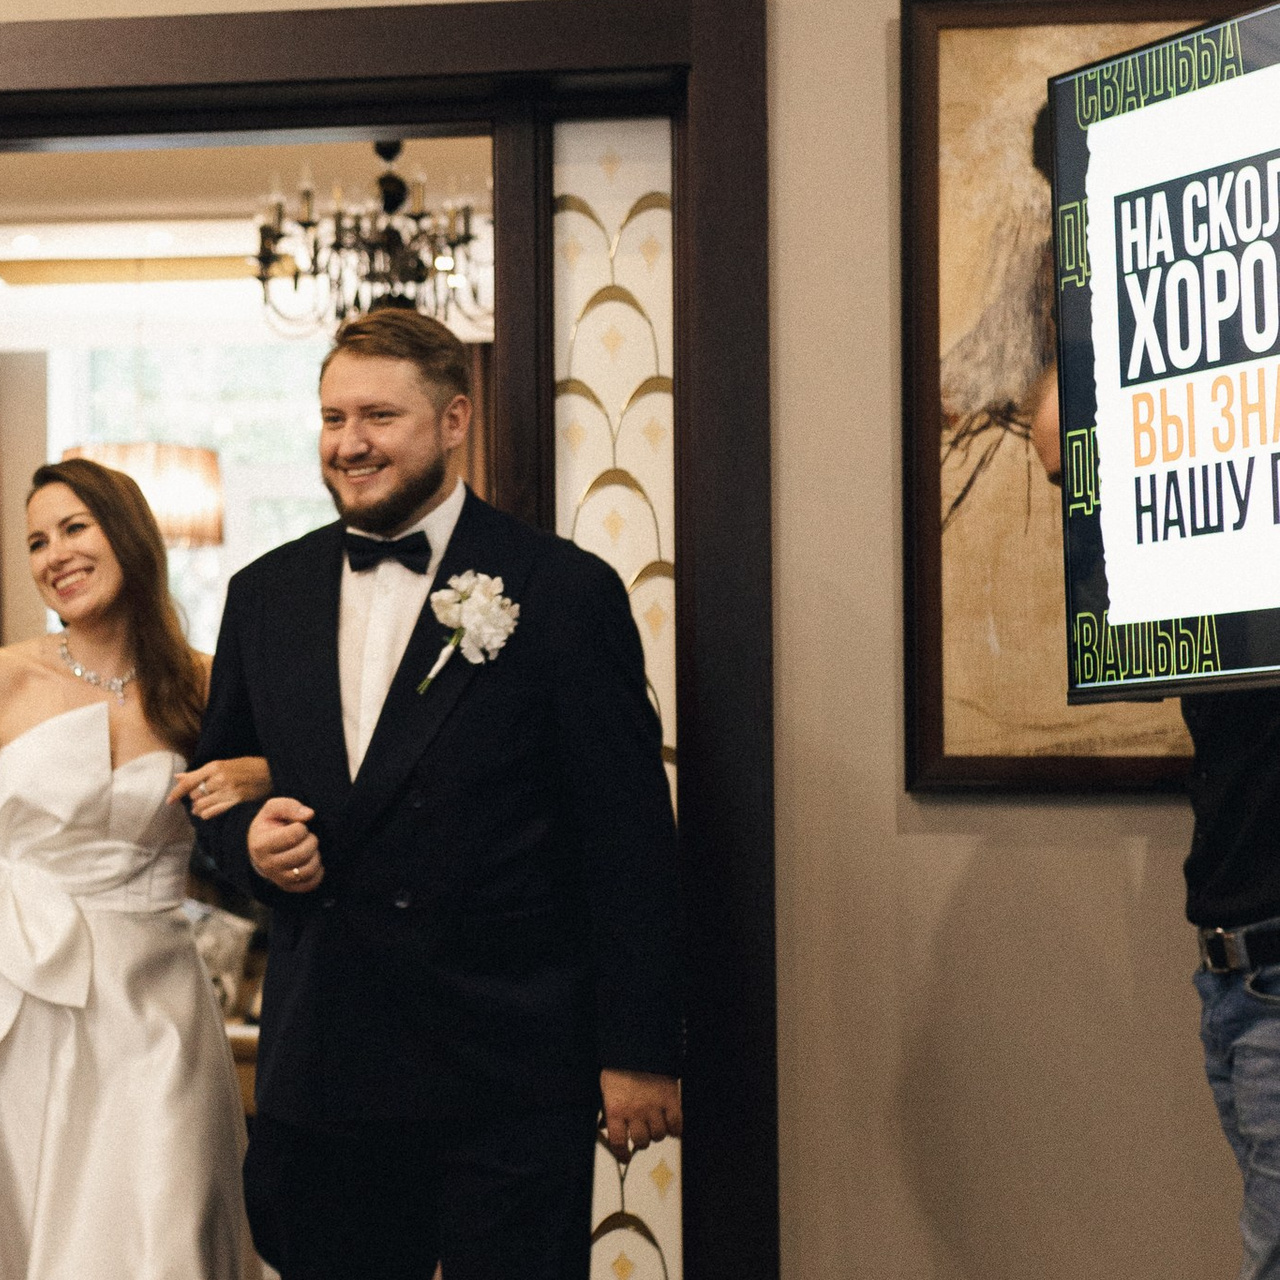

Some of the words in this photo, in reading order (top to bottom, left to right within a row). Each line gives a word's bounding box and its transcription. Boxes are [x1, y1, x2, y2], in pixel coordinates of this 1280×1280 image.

[1121, 191, 1175, 274] НА
[1125, 240, 1280, 379] ХОРО
[1132, 383, 1196, 468] ВЫ
[1134, 456, 1256, 545] НАШУ
[1073, 610, 1221, 685] ВАДЬБА
